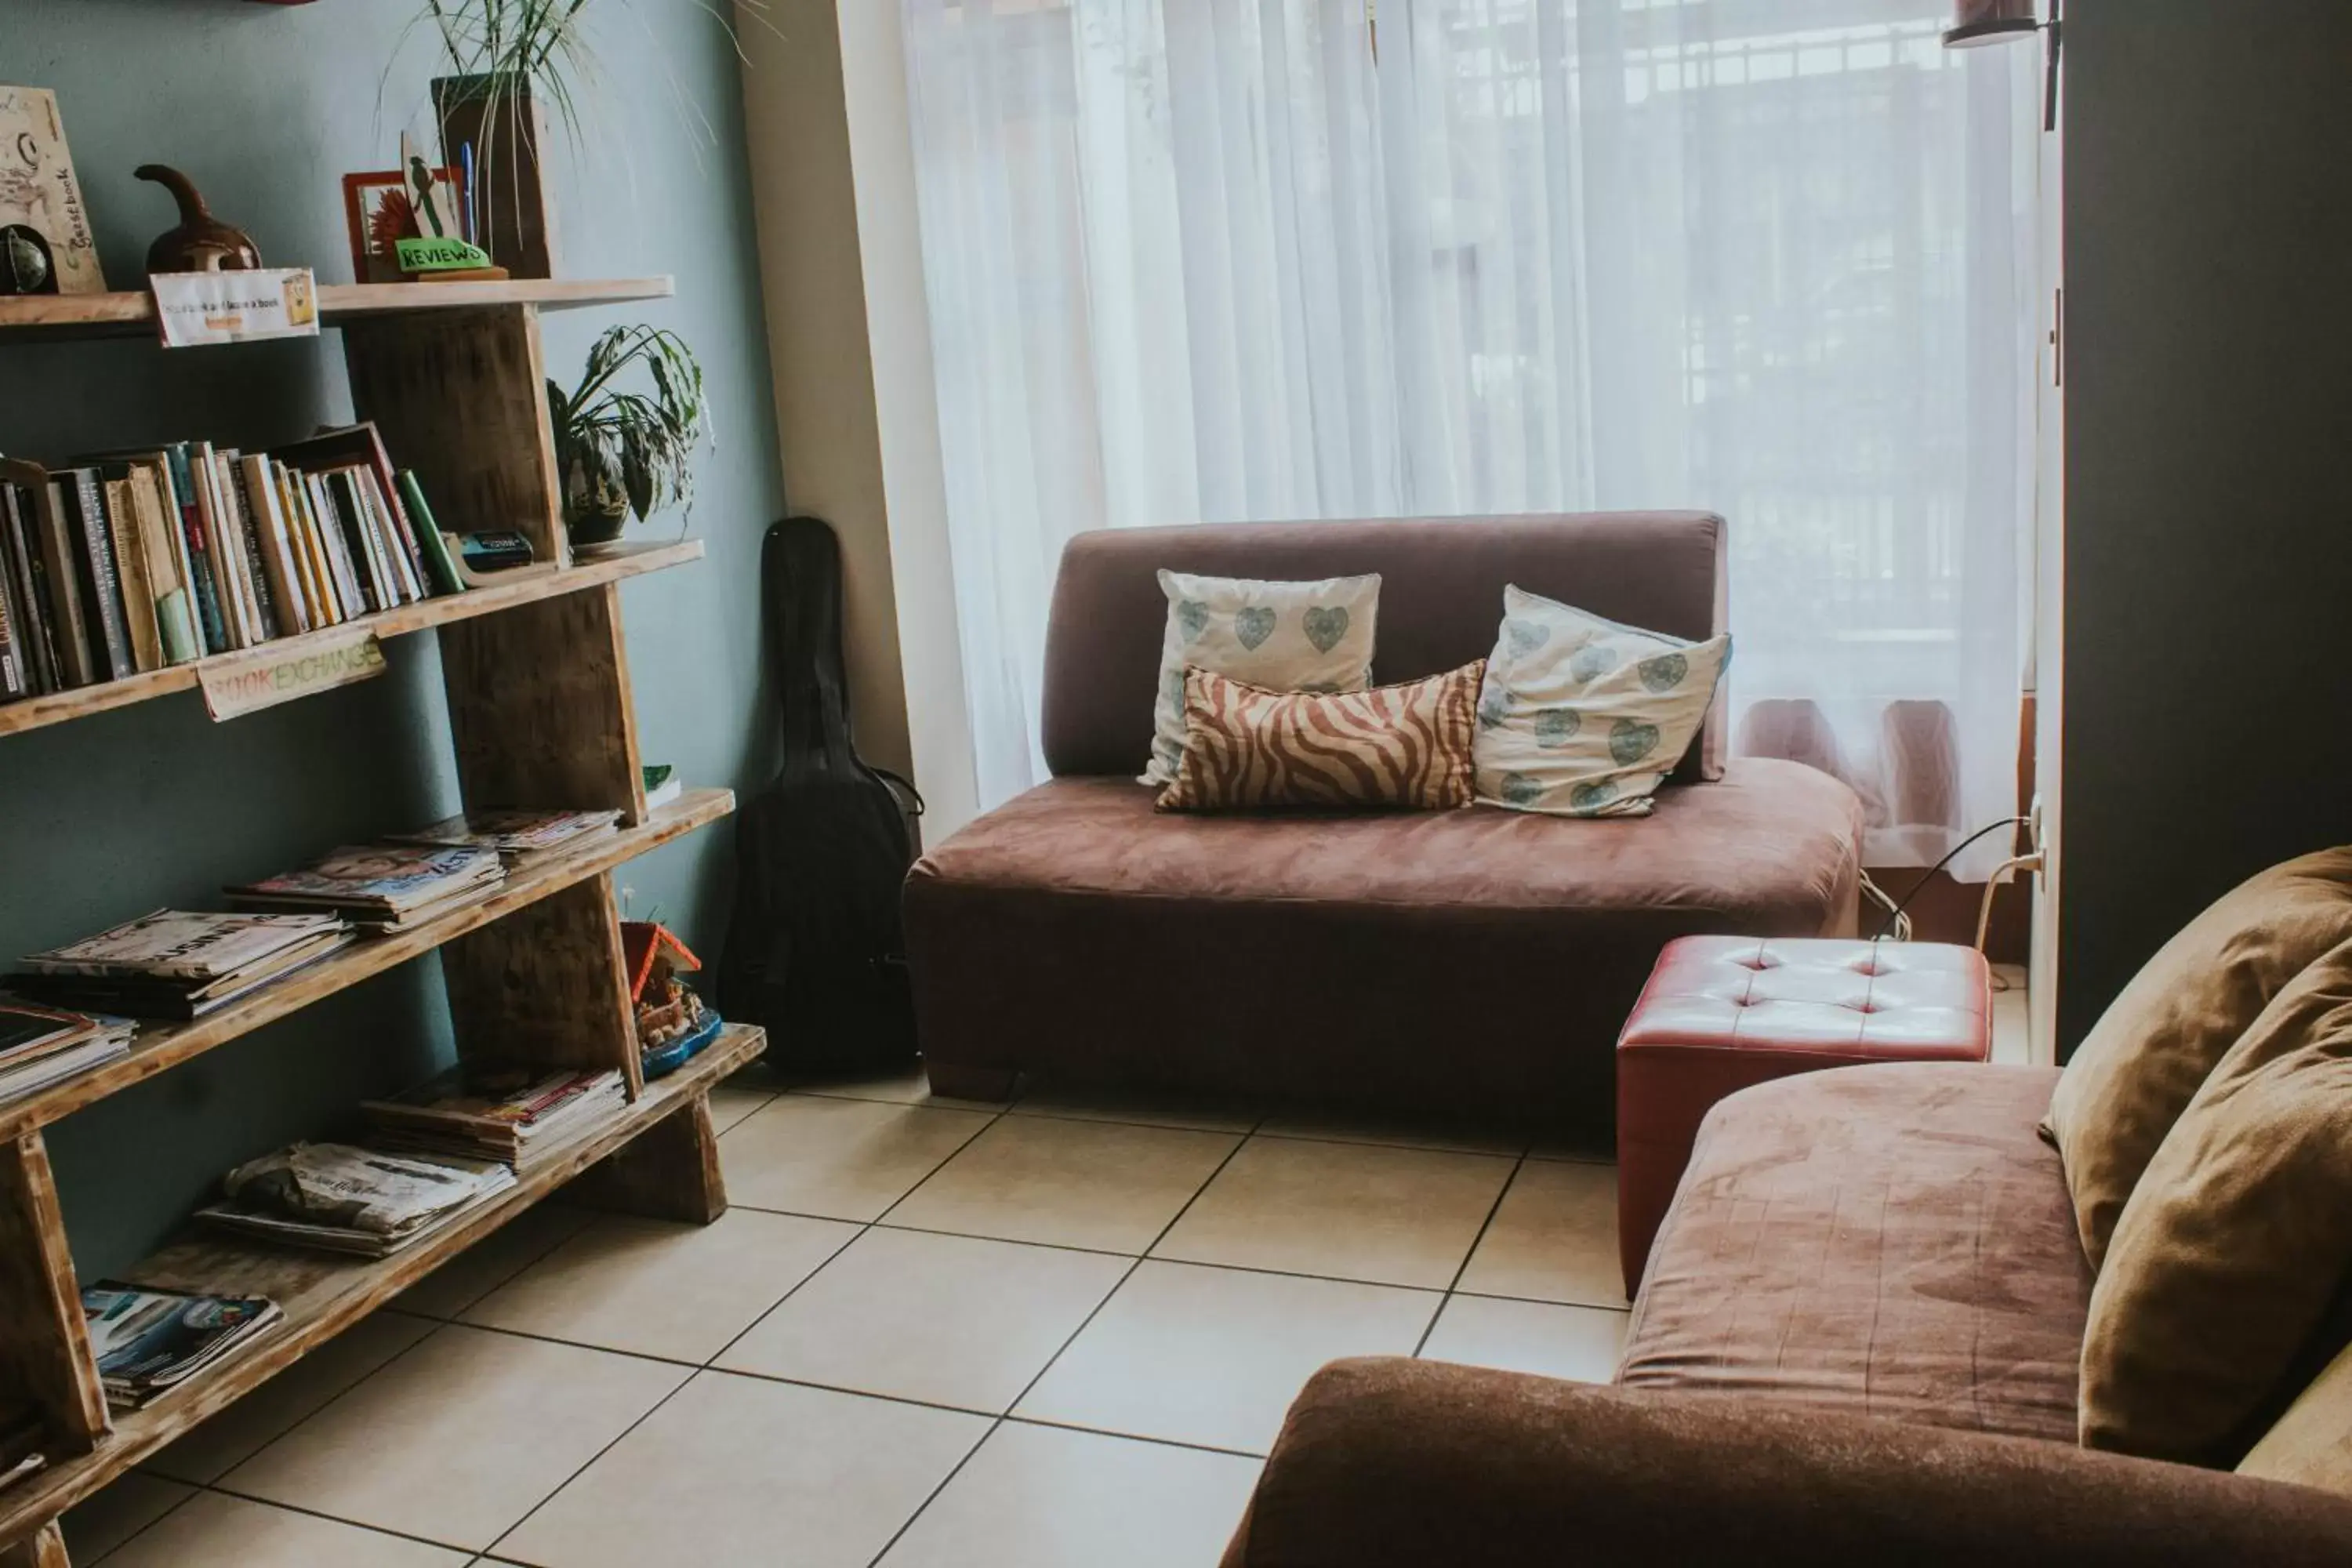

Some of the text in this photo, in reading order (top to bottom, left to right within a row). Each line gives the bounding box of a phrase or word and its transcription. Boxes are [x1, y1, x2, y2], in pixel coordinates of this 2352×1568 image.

[401, 247, 481, 267] REVIEWS
[101, 539, 114, 588] WINTER
[275, 641, 379, 690] EXCHANGE
